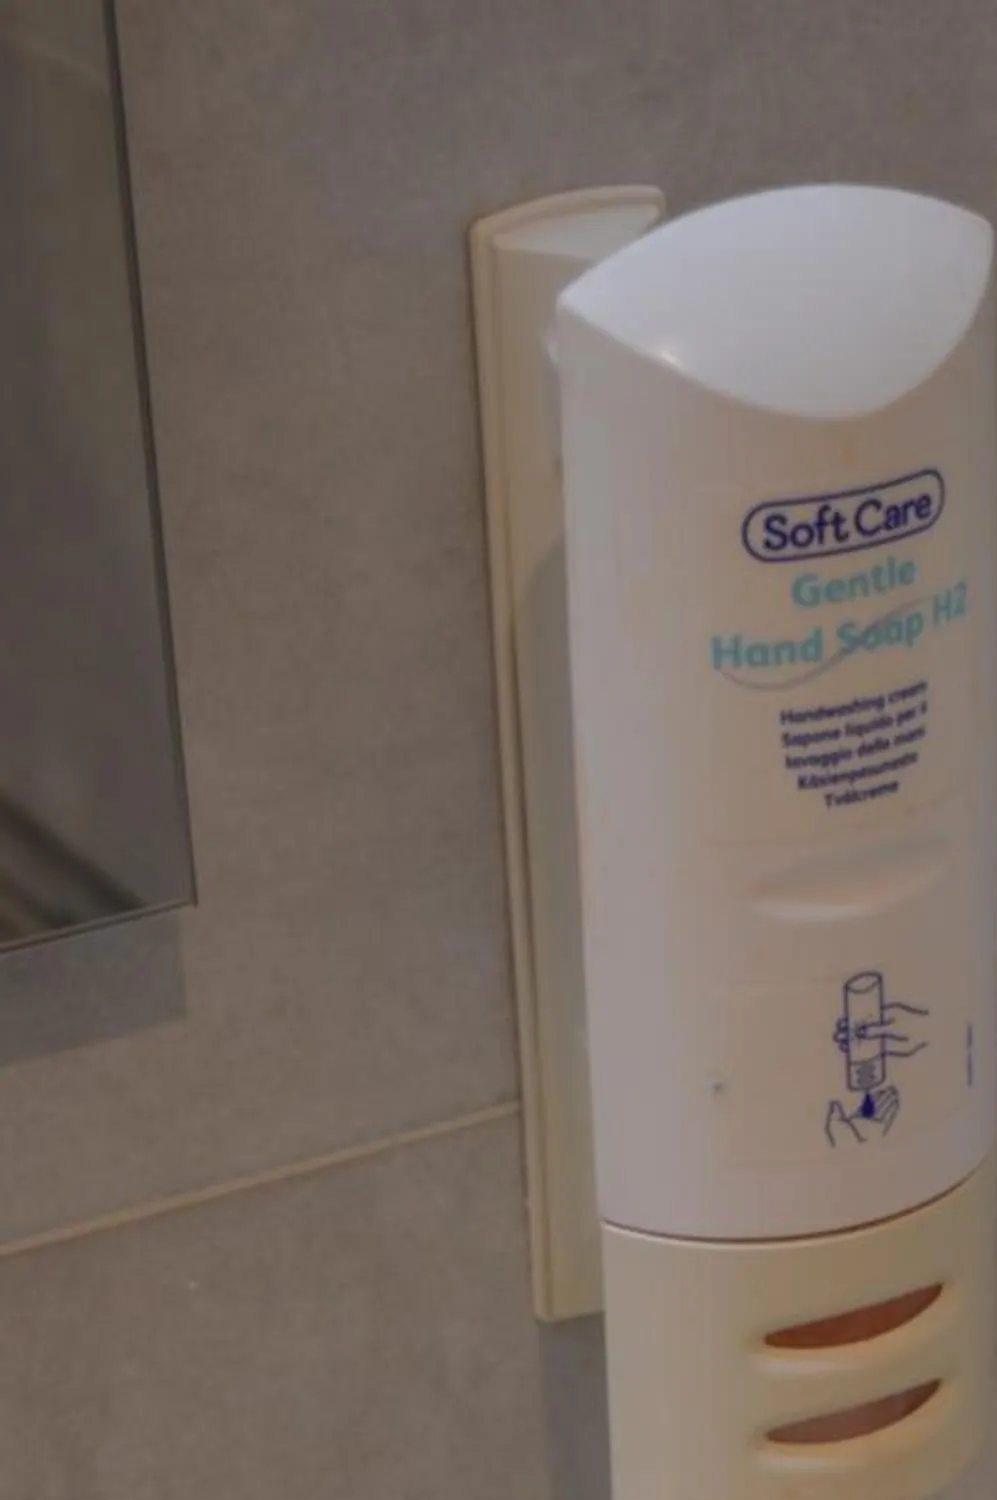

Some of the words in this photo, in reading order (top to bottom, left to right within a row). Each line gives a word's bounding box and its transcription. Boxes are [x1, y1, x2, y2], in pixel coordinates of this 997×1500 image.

[763, 505, 848, 551] Soft
[855, 493, 932, 536] Care
[792, 555, 916, 607] Gentle
[710, 626, 824, 670] Hand
[836, 609, 924, 655] Soap
[932, 579, 968, 627] H2
[780, 694, 885, 725] Handwashing
[781, 729, 842, 748] Sapone
